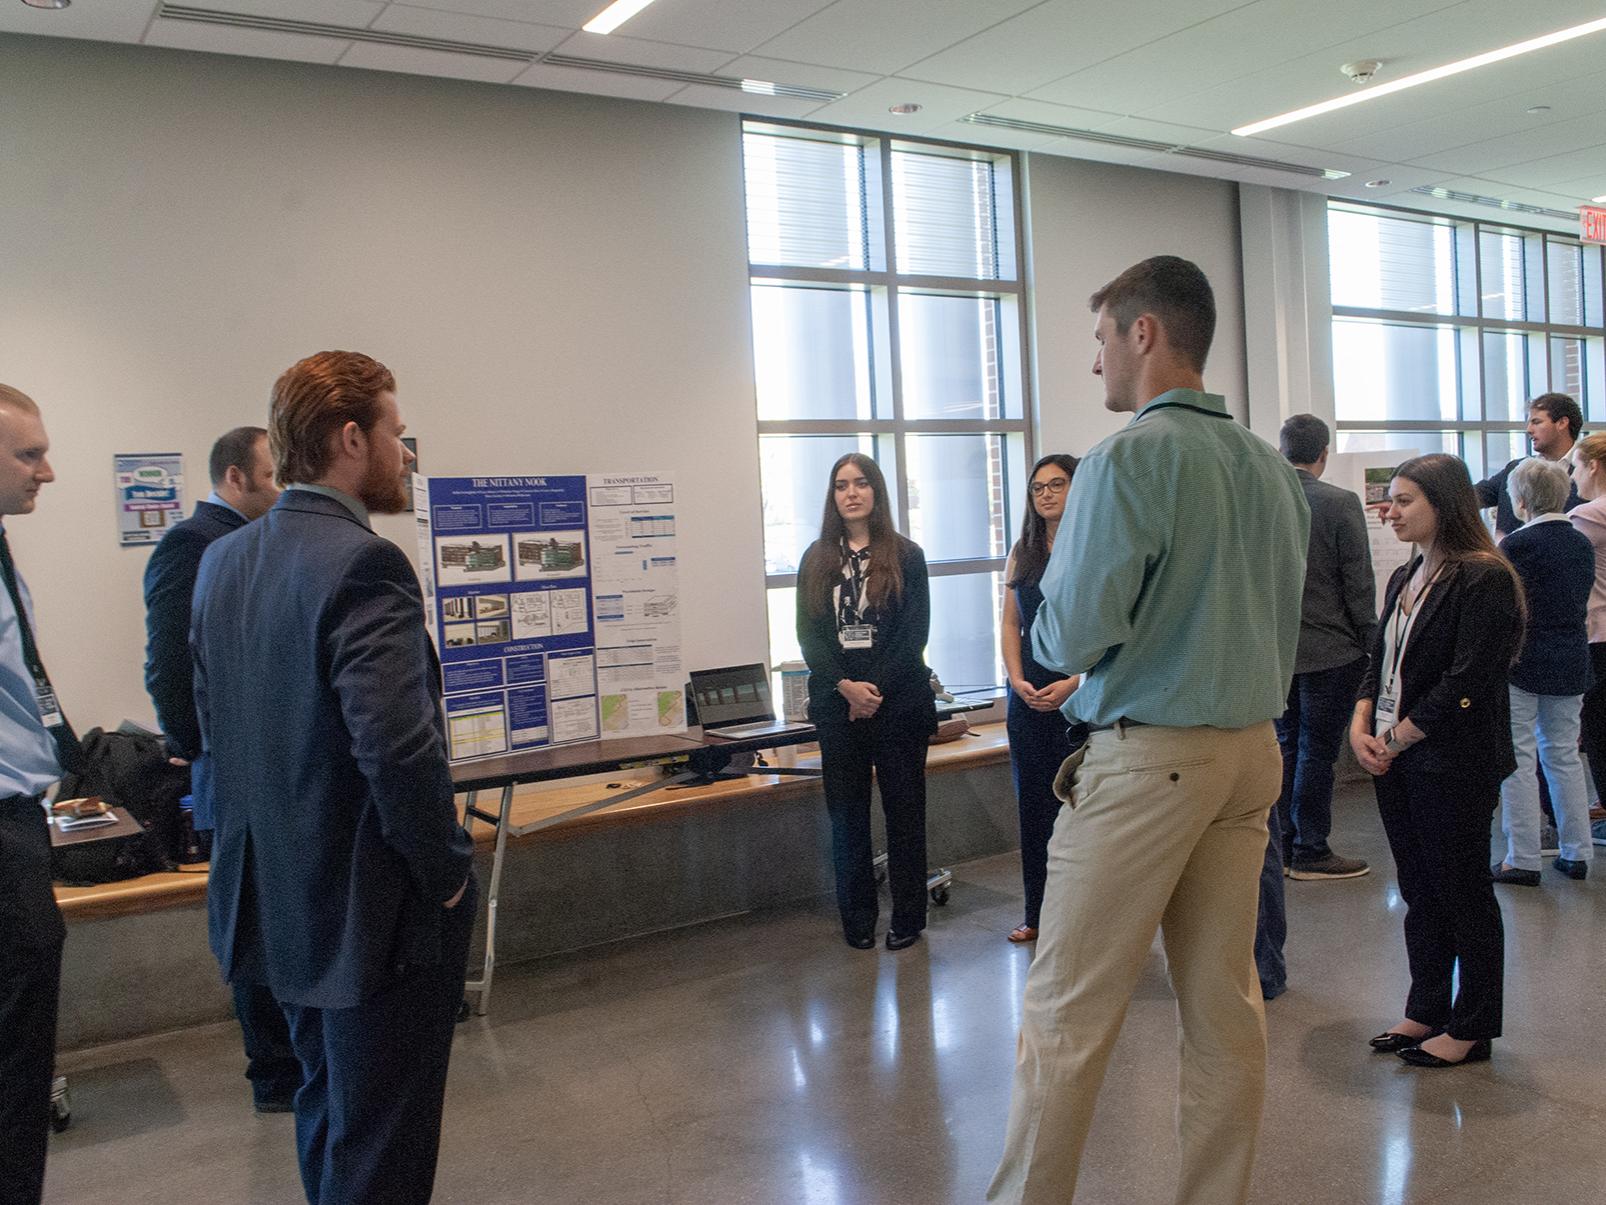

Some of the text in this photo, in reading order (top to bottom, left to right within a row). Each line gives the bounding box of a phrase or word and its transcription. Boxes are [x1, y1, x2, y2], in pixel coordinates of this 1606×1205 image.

[472, 477, 547, 487] THE NITTANY NOOK
[504, 644, 543, 653] CONSTRUCTION
